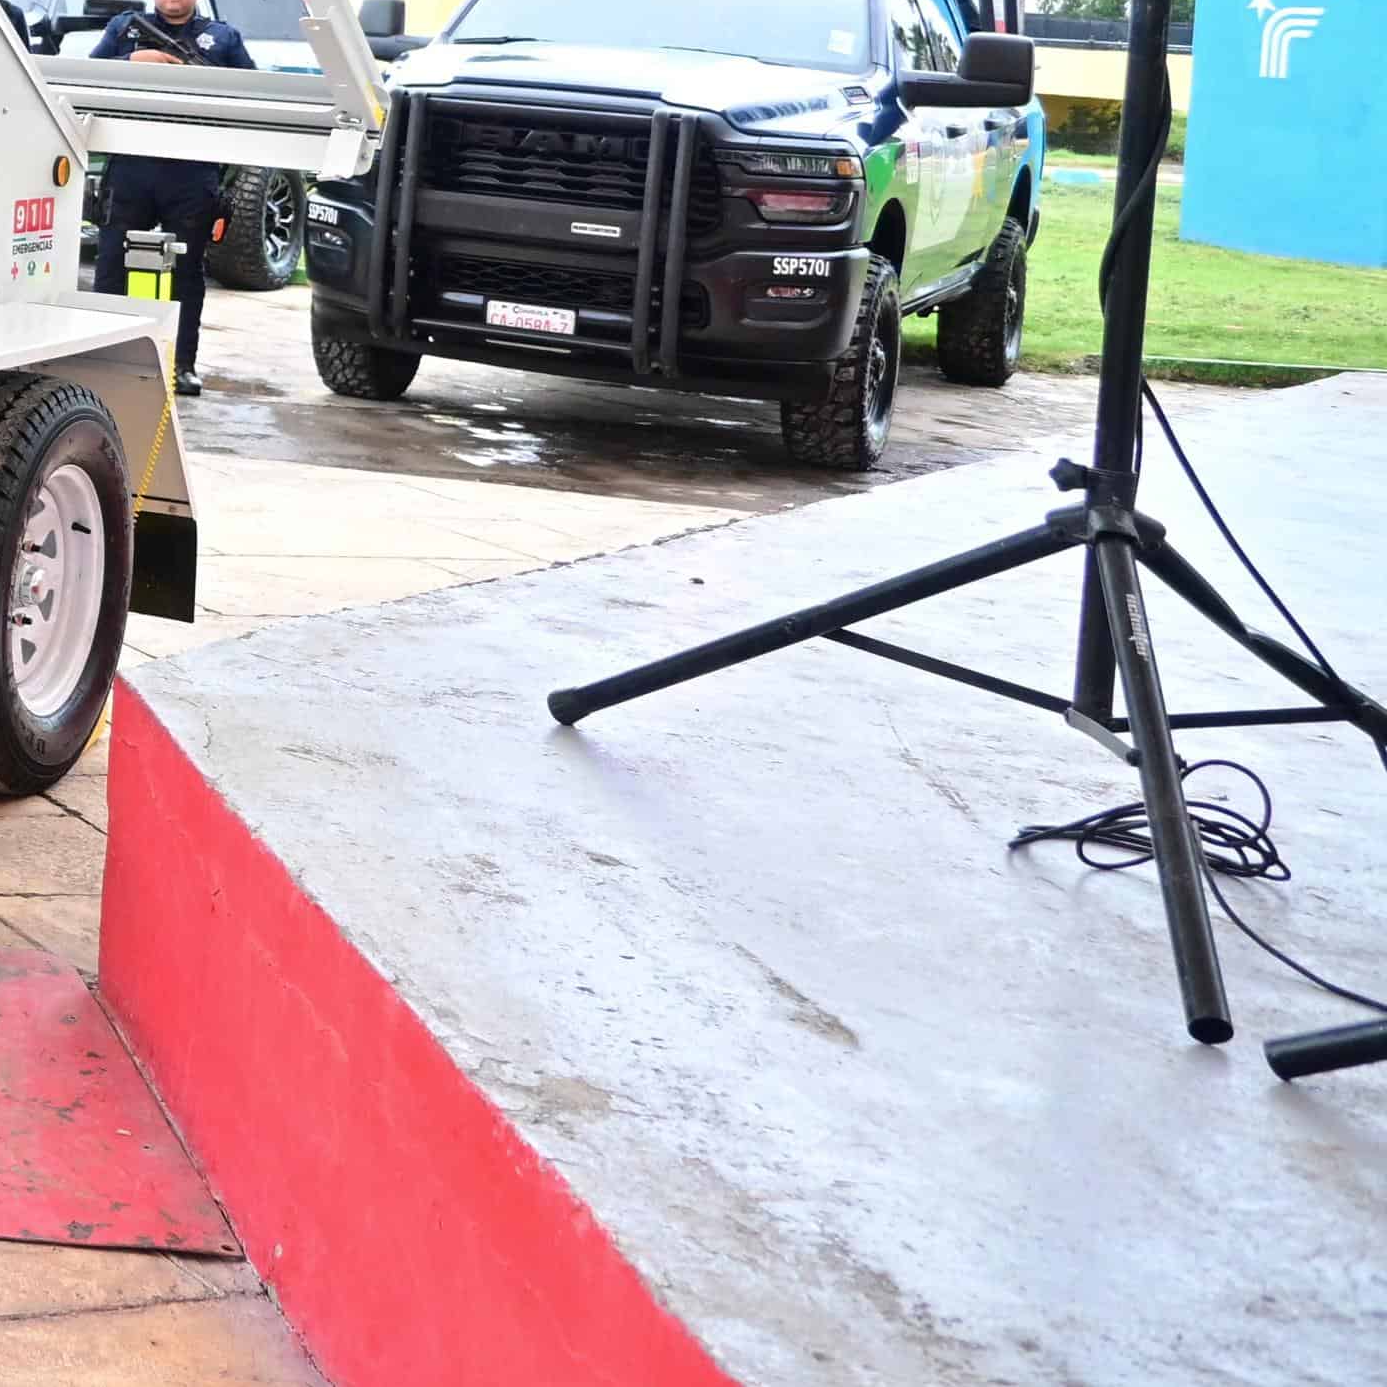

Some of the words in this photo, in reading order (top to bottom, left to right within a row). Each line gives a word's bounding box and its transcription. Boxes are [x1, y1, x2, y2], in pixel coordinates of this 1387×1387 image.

[15, 198, 54, 230] 911
[12, 239, 54, 255] EMERGENCIAS
[772, 257, 831, 278] SSP5701
